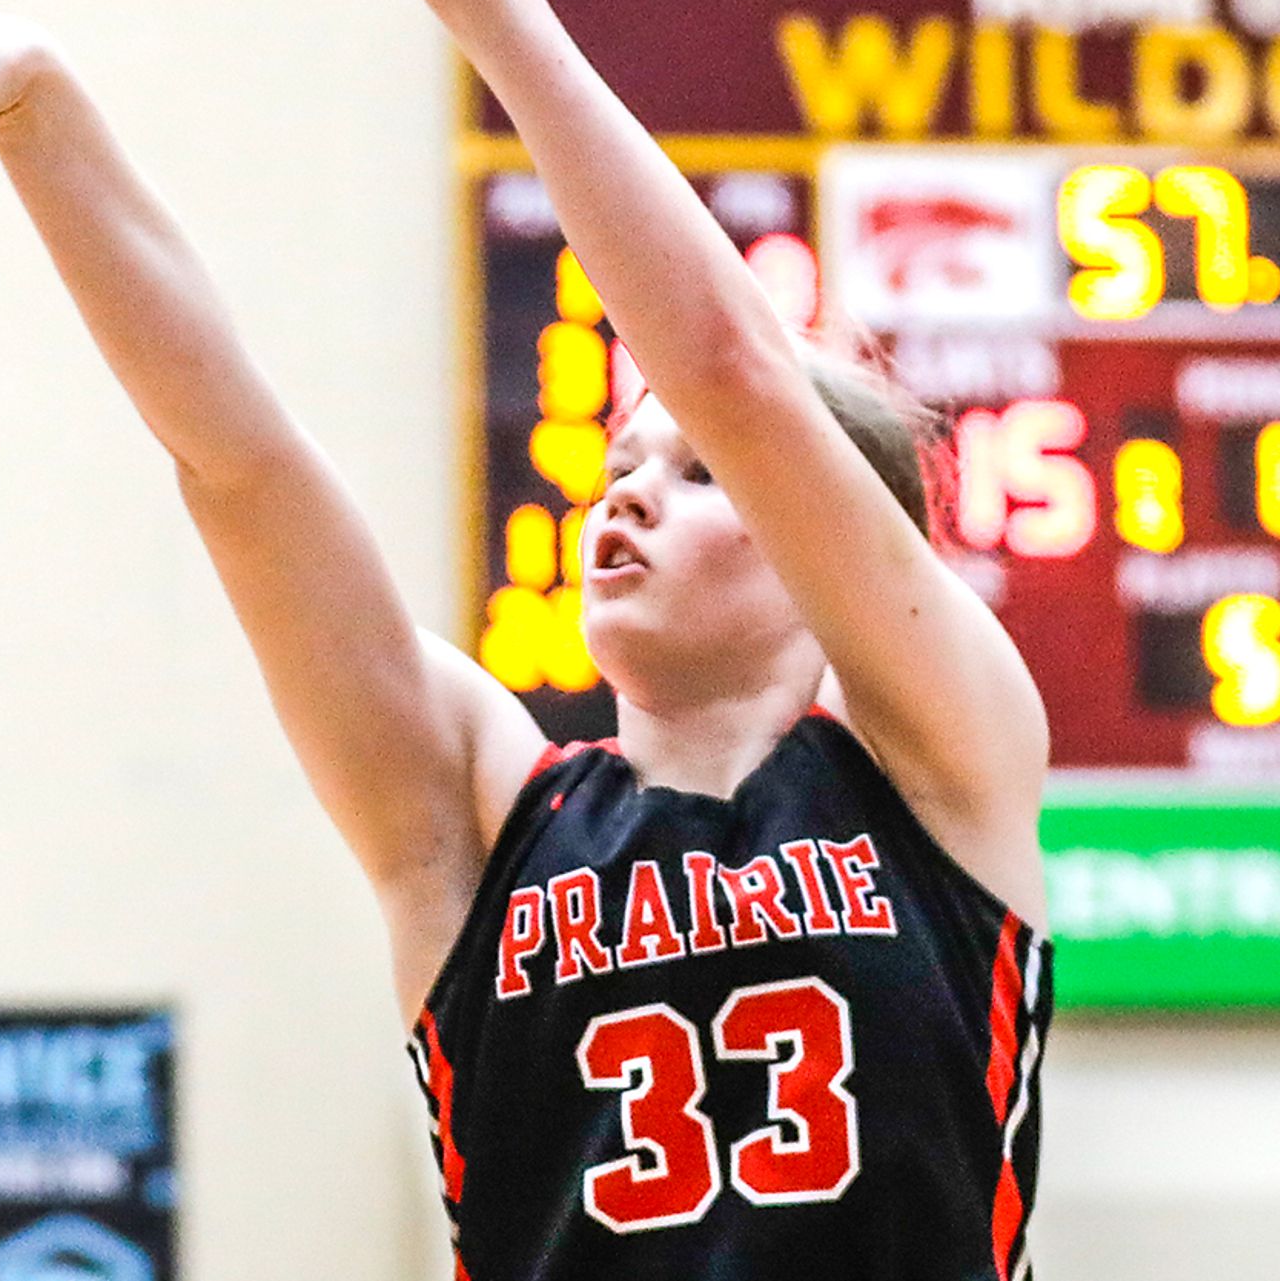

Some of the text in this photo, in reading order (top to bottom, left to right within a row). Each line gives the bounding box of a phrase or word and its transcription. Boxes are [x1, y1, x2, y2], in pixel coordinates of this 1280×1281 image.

[952, 398, 1098, 558] 15
[496, 834, 898, 1000] PRAIRIE
[576, 976, 860, 1235] 33
